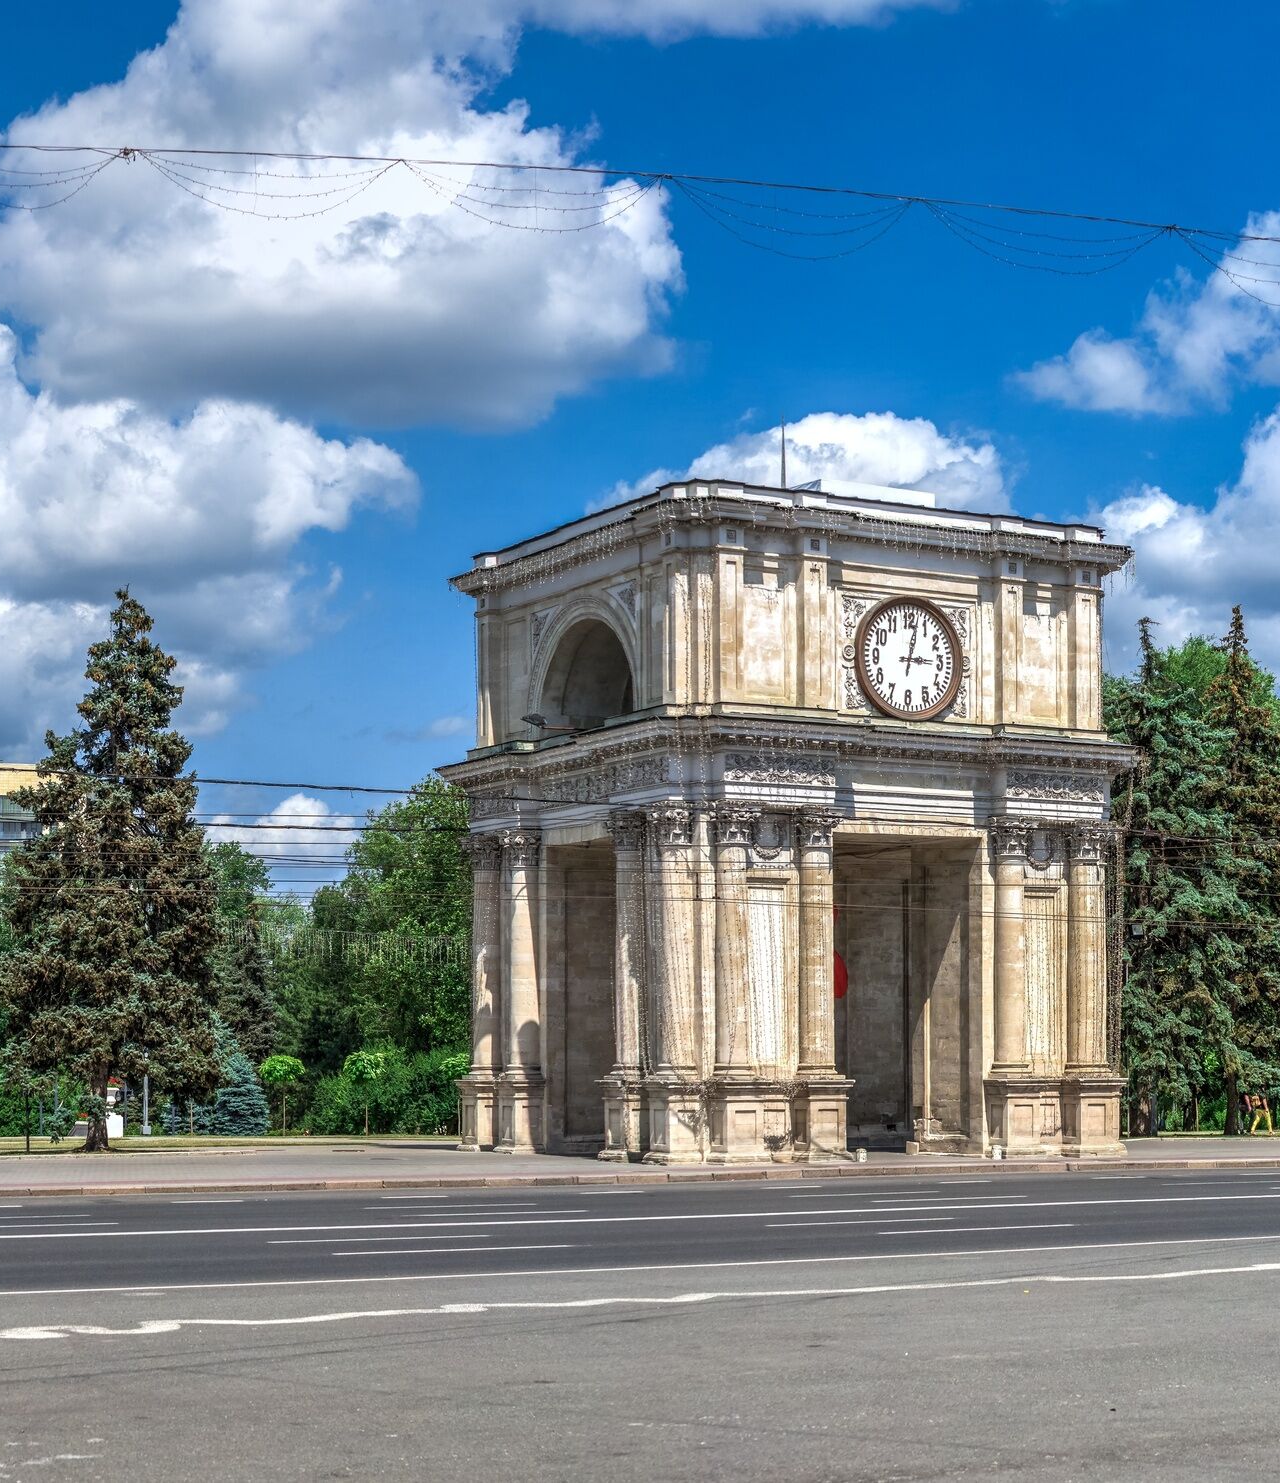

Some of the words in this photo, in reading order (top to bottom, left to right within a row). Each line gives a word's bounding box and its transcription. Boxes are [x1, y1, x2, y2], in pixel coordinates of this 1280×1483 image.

[888, 614, 897, 633] 11
[904, 611, 916, 629] 12
[922, 620, 927, 638] 1
[875, 628, 887, 646] 10
[932, 634, 939, 652] 2
[872, 647, 880, 665] 9
[936, 654, 943, 672] 3
[876, 667, 883, 685] 8
[933, 673, 940, 691] 4
[888, 683, 896, 700] 7
[904, 689, 912, 706] 6
[921, 686, 929, 704] 5
